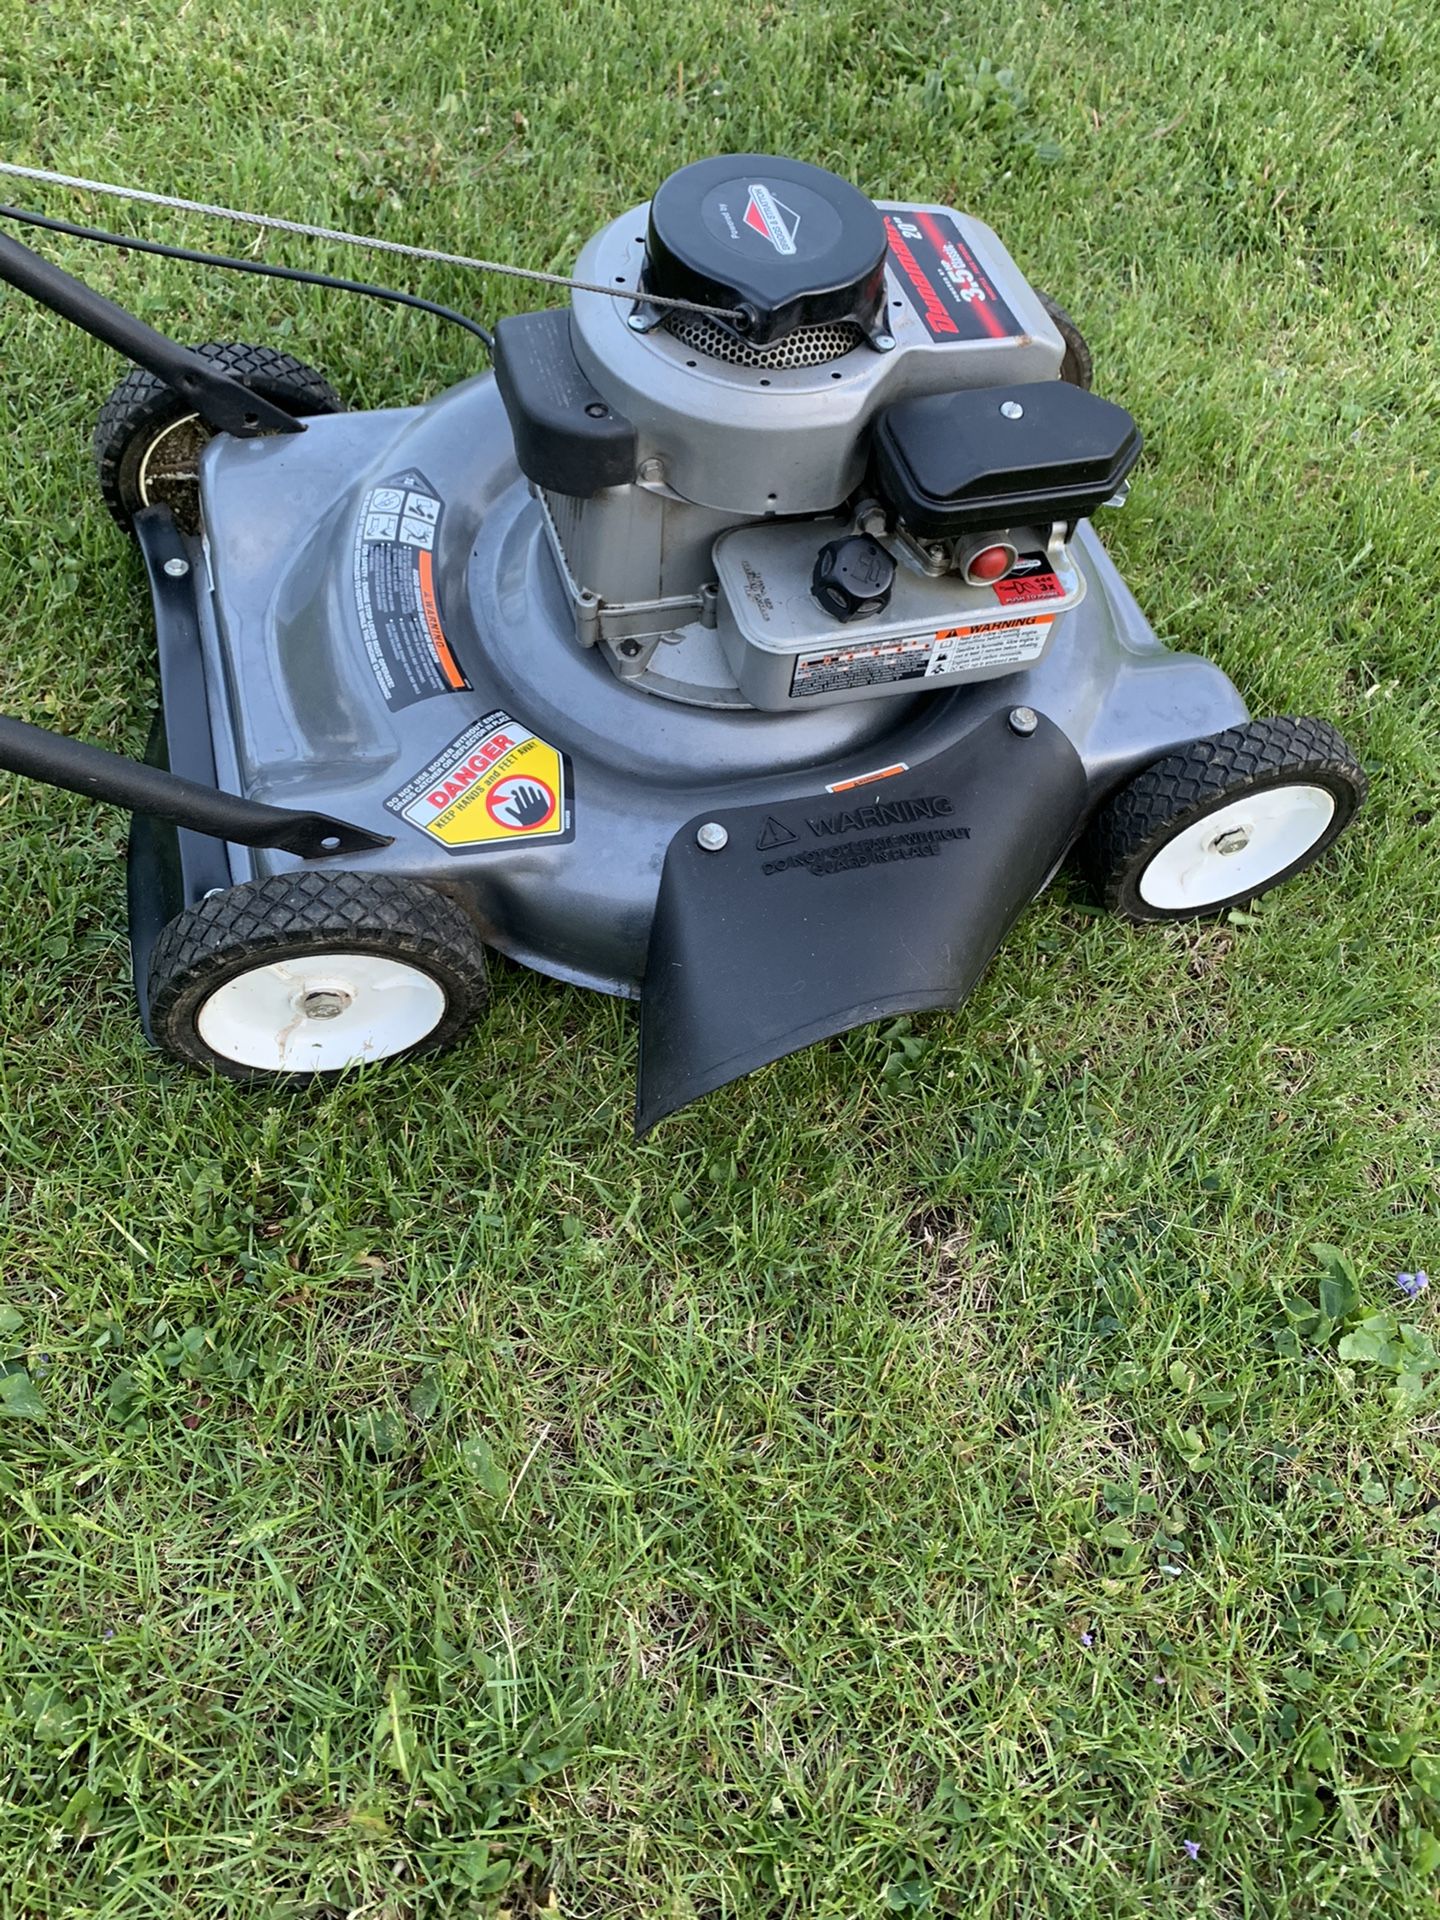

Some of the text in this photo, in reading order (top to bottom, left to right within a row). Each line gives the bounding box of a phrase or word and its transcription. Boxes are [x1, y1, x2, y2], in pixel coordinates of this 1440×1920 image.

[718, 204, 740, 238] Powered by
[943, 243, 966, 270] Classic
[943, 276, 961, 302] POWERED
[947, 269, 986, 302] 3.5
[425, 600, 444, 648] WARNING
[969, 616, 1037, 634] WARNING
[386, 797, 399, 807] DO
[398, 783, 414, 798] NOT
[414, 771, 430, 785] USE
[428, 748, 454, 771] MOWER
[453, 722, 483, 748] WITHOUT
[393, 715, 511, 811] GRASS CATCHER OR DEFLECTOR IN PLACE
[426, 734, 515, 810] DANGER
[435, 741, 538, 829] KEEP HANDS and FEET AWAY
[805, 795, 955, 838] WARNING
[762, 827, 972, 876] DO NOT OPERATE WITHOUT
[810, 843, 941, 877] GUARD IN PLACE
